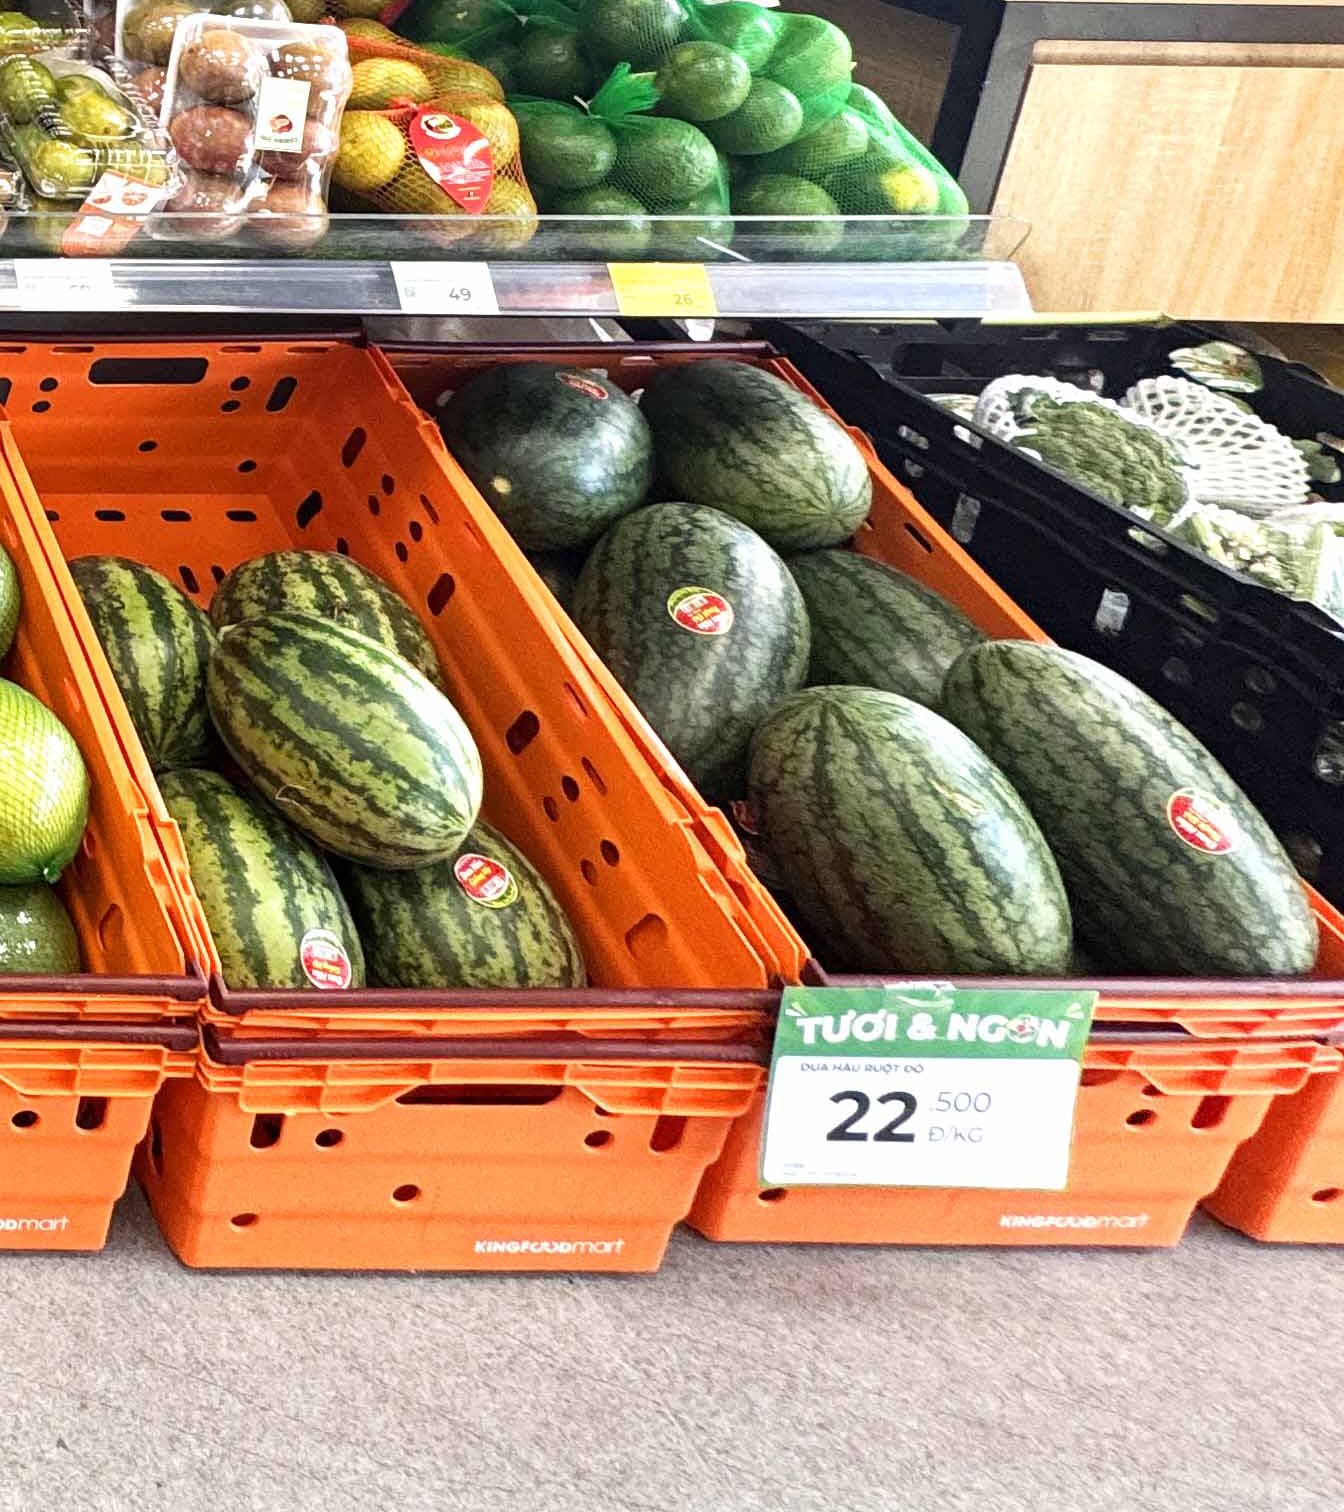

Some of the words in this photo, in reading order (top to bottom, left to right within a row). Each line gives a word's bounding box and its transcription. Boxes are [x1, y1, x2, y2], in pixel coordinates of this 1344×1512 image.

[448, 287, 472, 301] 49
[673, 292, 694, 306] 26
[796, 1008, 899, 1045] TƯƠI
[906, 1012, 937, 1041] &
[825, 1089, 919, 1144] 22
